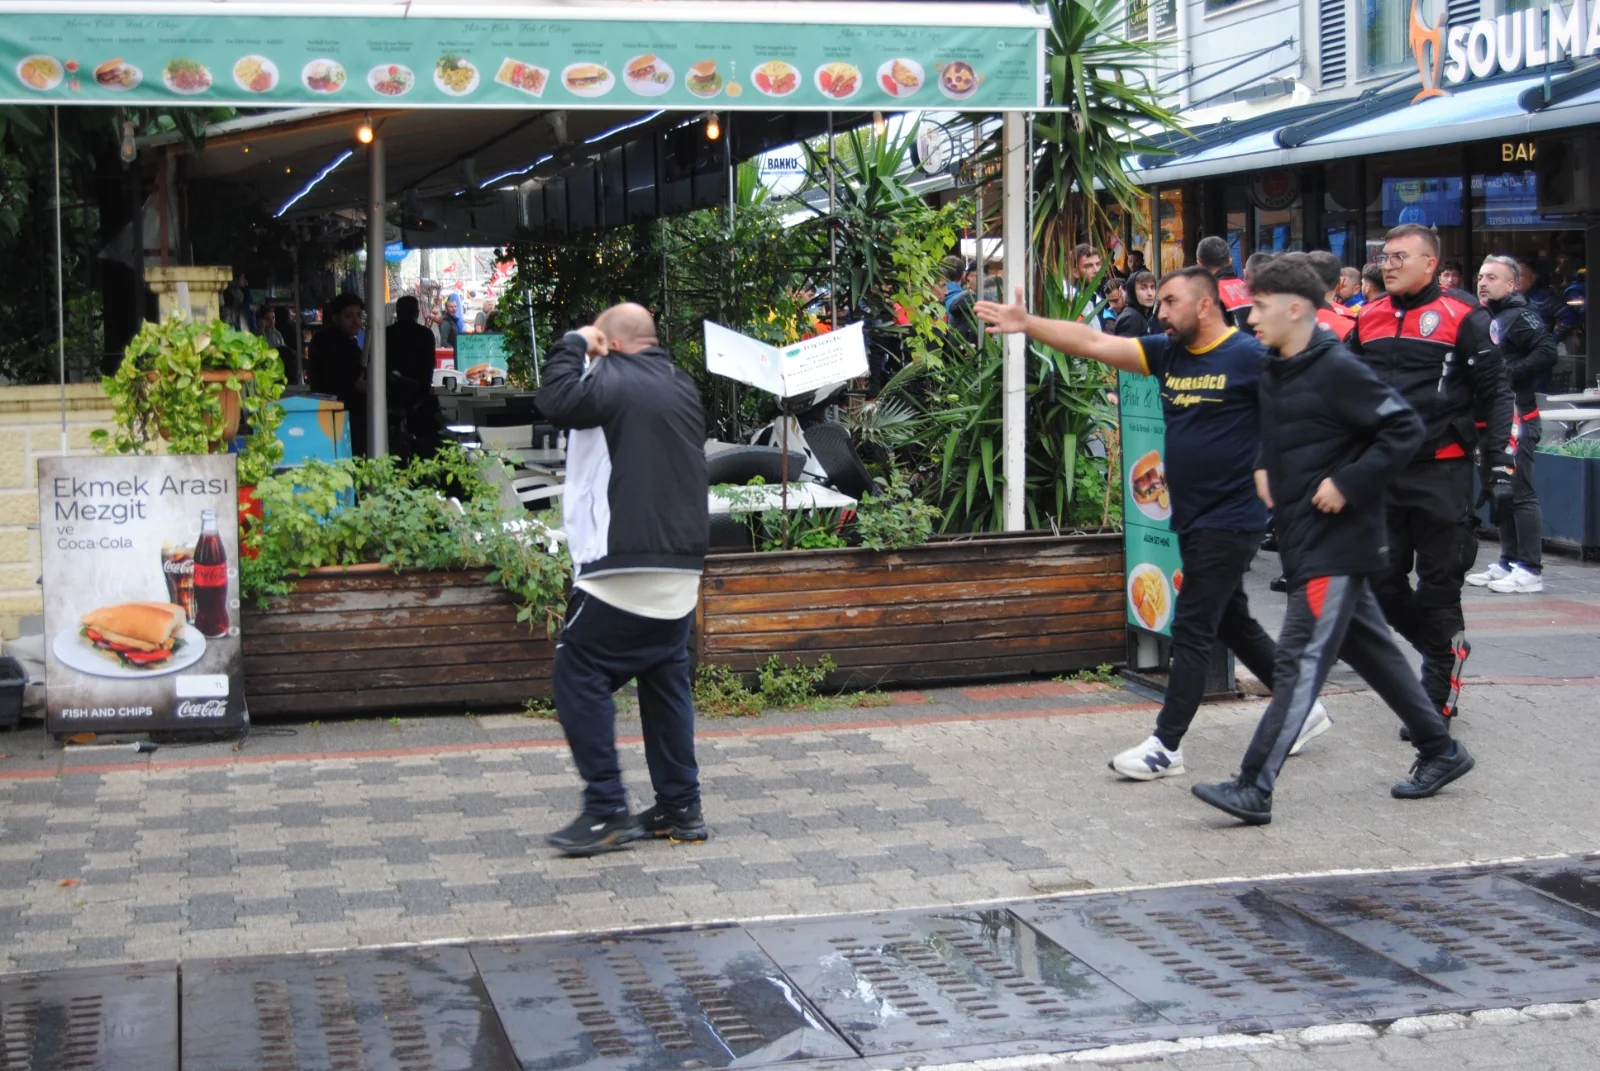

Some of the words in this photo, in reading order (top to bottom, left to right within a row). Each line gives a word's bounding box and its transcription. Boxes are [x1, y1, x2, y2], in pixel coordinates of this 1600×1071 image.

[767, 157, 798, 170] BAKKU
[54, 475, 149, 499] Ekmek
[159, 475, 229, 496] Arası
[55, 500, 147, 525] Mezgit
[57, 525, 75, 536] ve
[57, 536, 133, 550] Coca-Cola
[164, 559, 195, 574] Coca-Co
[214, 681, 224, 689] TL
[62, 708, 89, 719] FISH
[91, 707, 116, 718] AND
[118, 706, 153, 717] CHIPS
[178, 699, 228, 718] Coca-Cola
